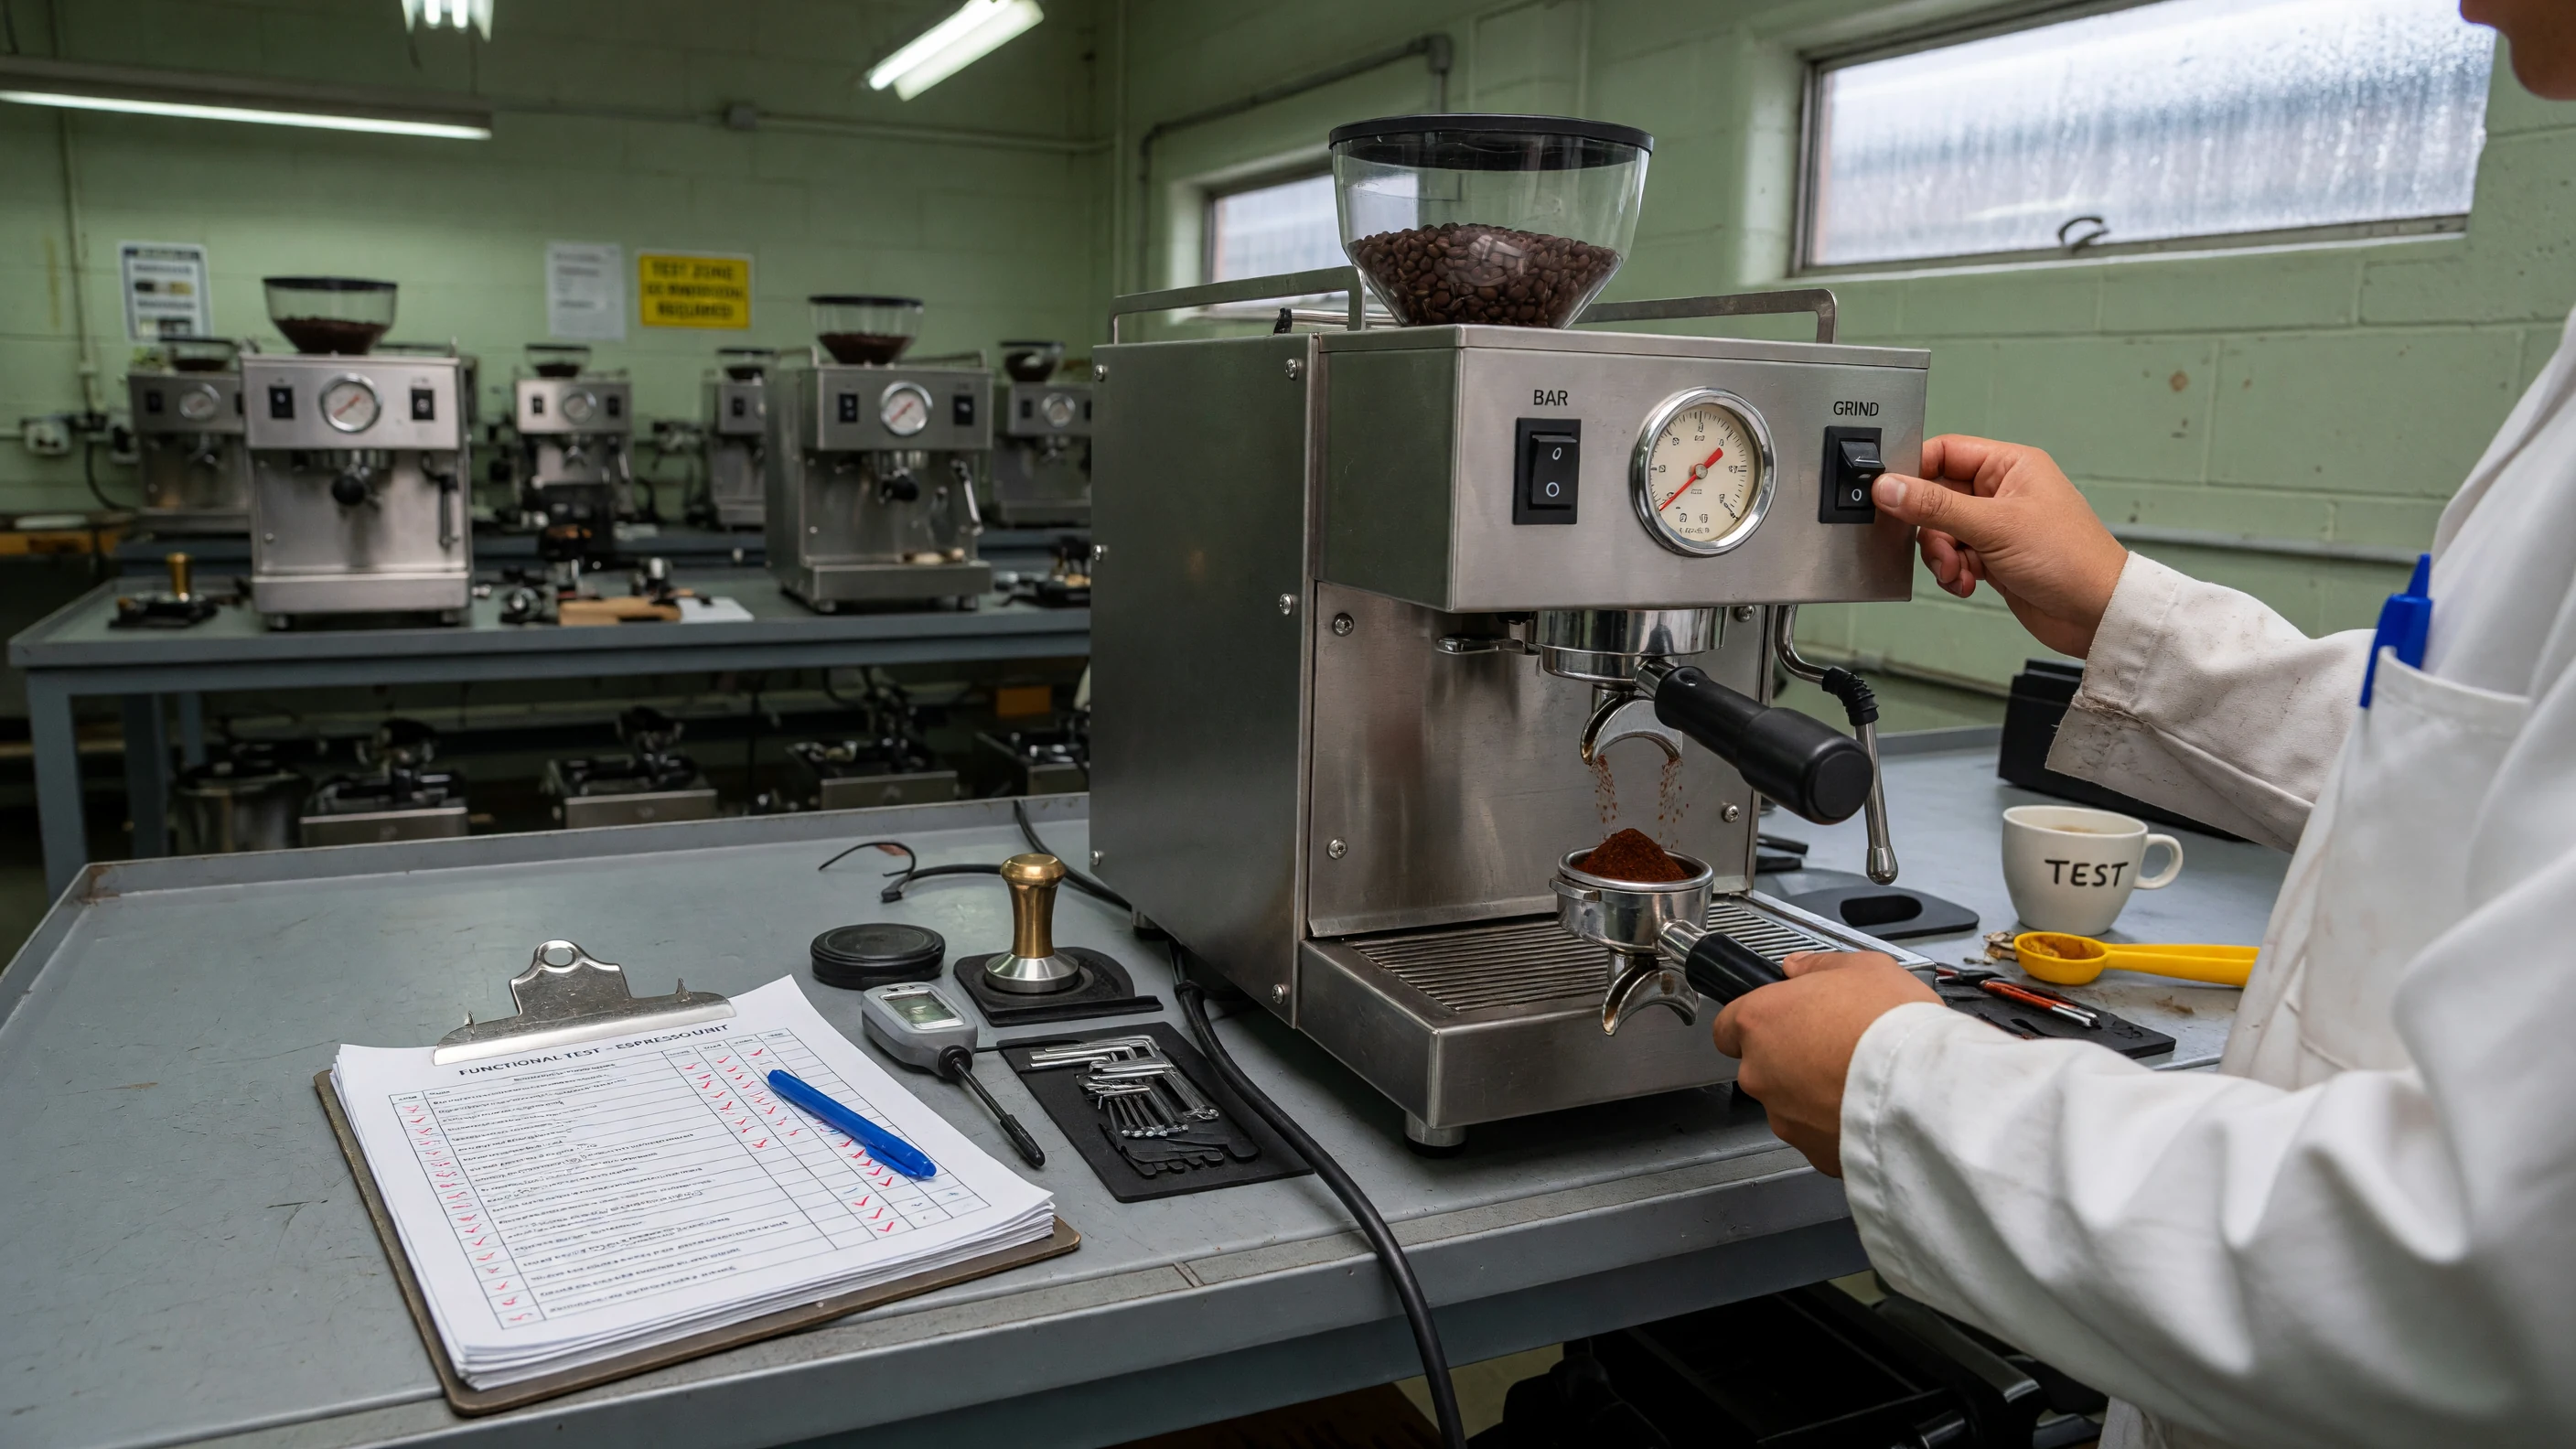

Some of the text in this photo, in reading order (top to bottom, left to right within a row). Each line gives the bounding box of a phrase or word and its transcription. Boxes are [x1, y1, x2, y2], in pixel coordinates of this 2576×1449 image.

[1533, 389, 1568, 406] BAR
[1833, 401, 1880, 417] GRIND
[2044, 859, 2130, 888] TEST
[458, 1055, 563, 1076] FUNCTIONAL
[564, 1047, 601, 1059] TEST
[615, 1032, 692, 1050] ESPRESSO
[692, 1024, 728, 1036] UNIT
